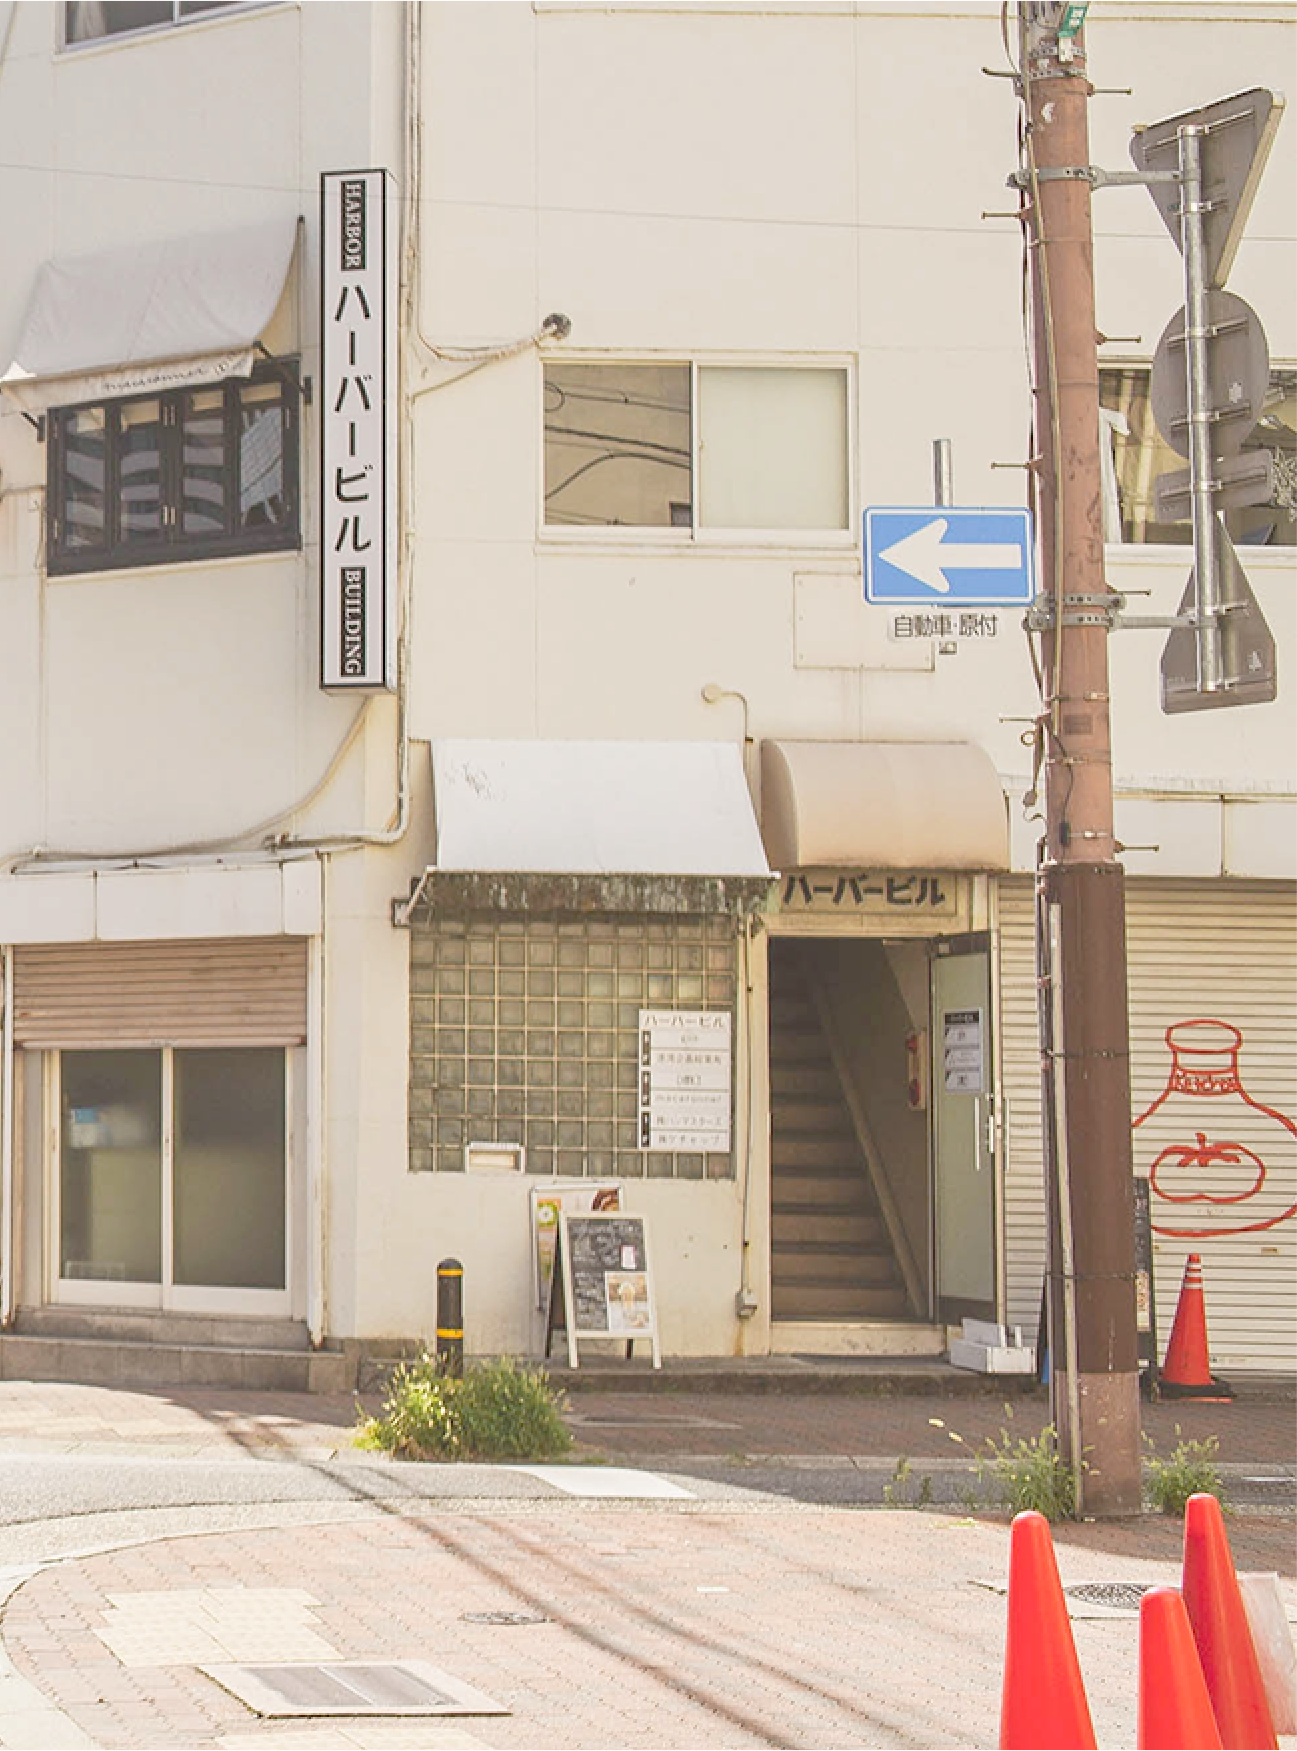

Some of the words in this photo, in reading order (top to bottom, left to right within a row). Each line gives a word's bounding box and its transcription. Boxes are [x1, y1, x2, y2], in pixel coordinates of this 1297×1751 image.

[344, 183, 362, 269] HARBOR
[333, 285, 374, 552] ハーバービル
[344, 570, 362, 675] BUILDING
[782, 872, 946, 907] ハーバービル
